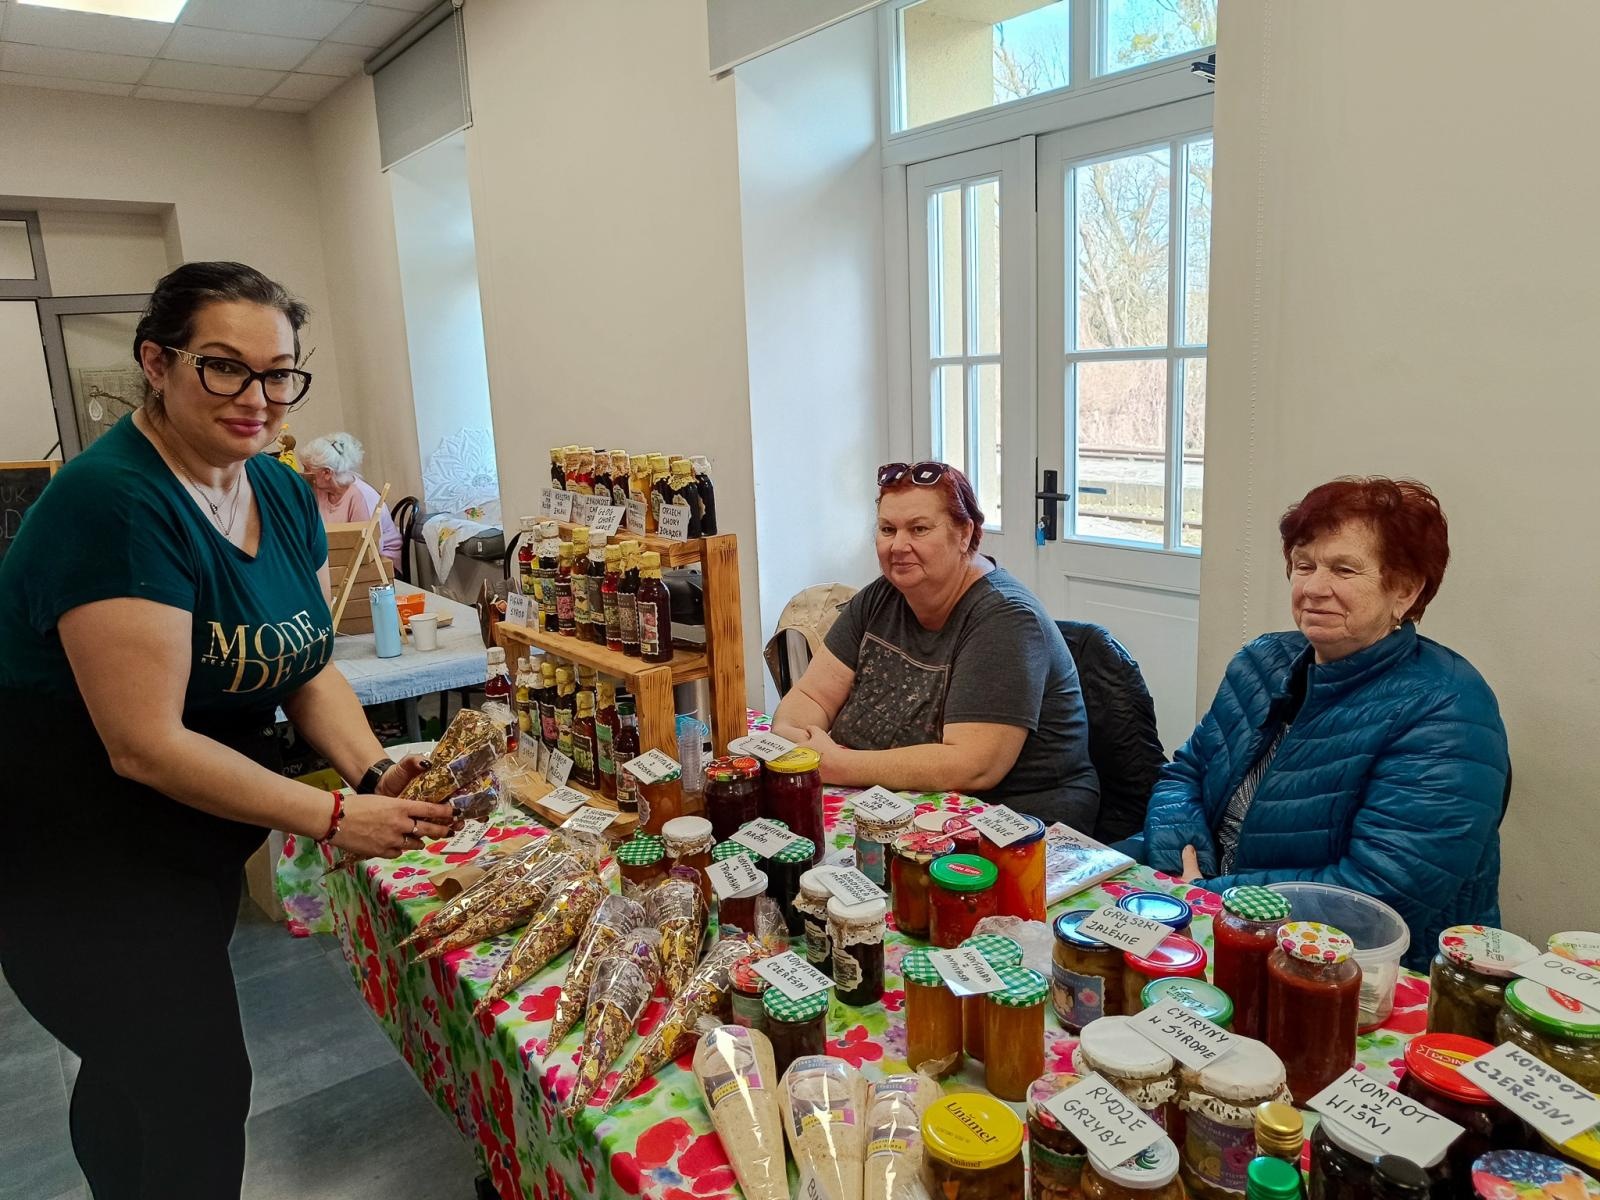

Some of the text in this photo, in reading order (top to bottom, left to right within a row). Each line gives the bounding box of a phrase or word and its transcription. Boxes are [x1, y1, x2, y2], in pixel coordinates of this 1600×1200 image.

[1086, 920, 1140, 945] ZALEWIE
[784, 953, 829, 987] KONFITURA
[1161, 1025, 1217, 1059] SYROPIE
[1167, 1007, 1230, 1043] CYTRYNY
[1505, 1050, 1596, 1101] KOMPOT
[1085, 1086, 1148, 1132] RYDZE
[1344, 1074, 1440, 1124] KOMPOT
[1063, 1100, 1127, 1147] GRZYBY
